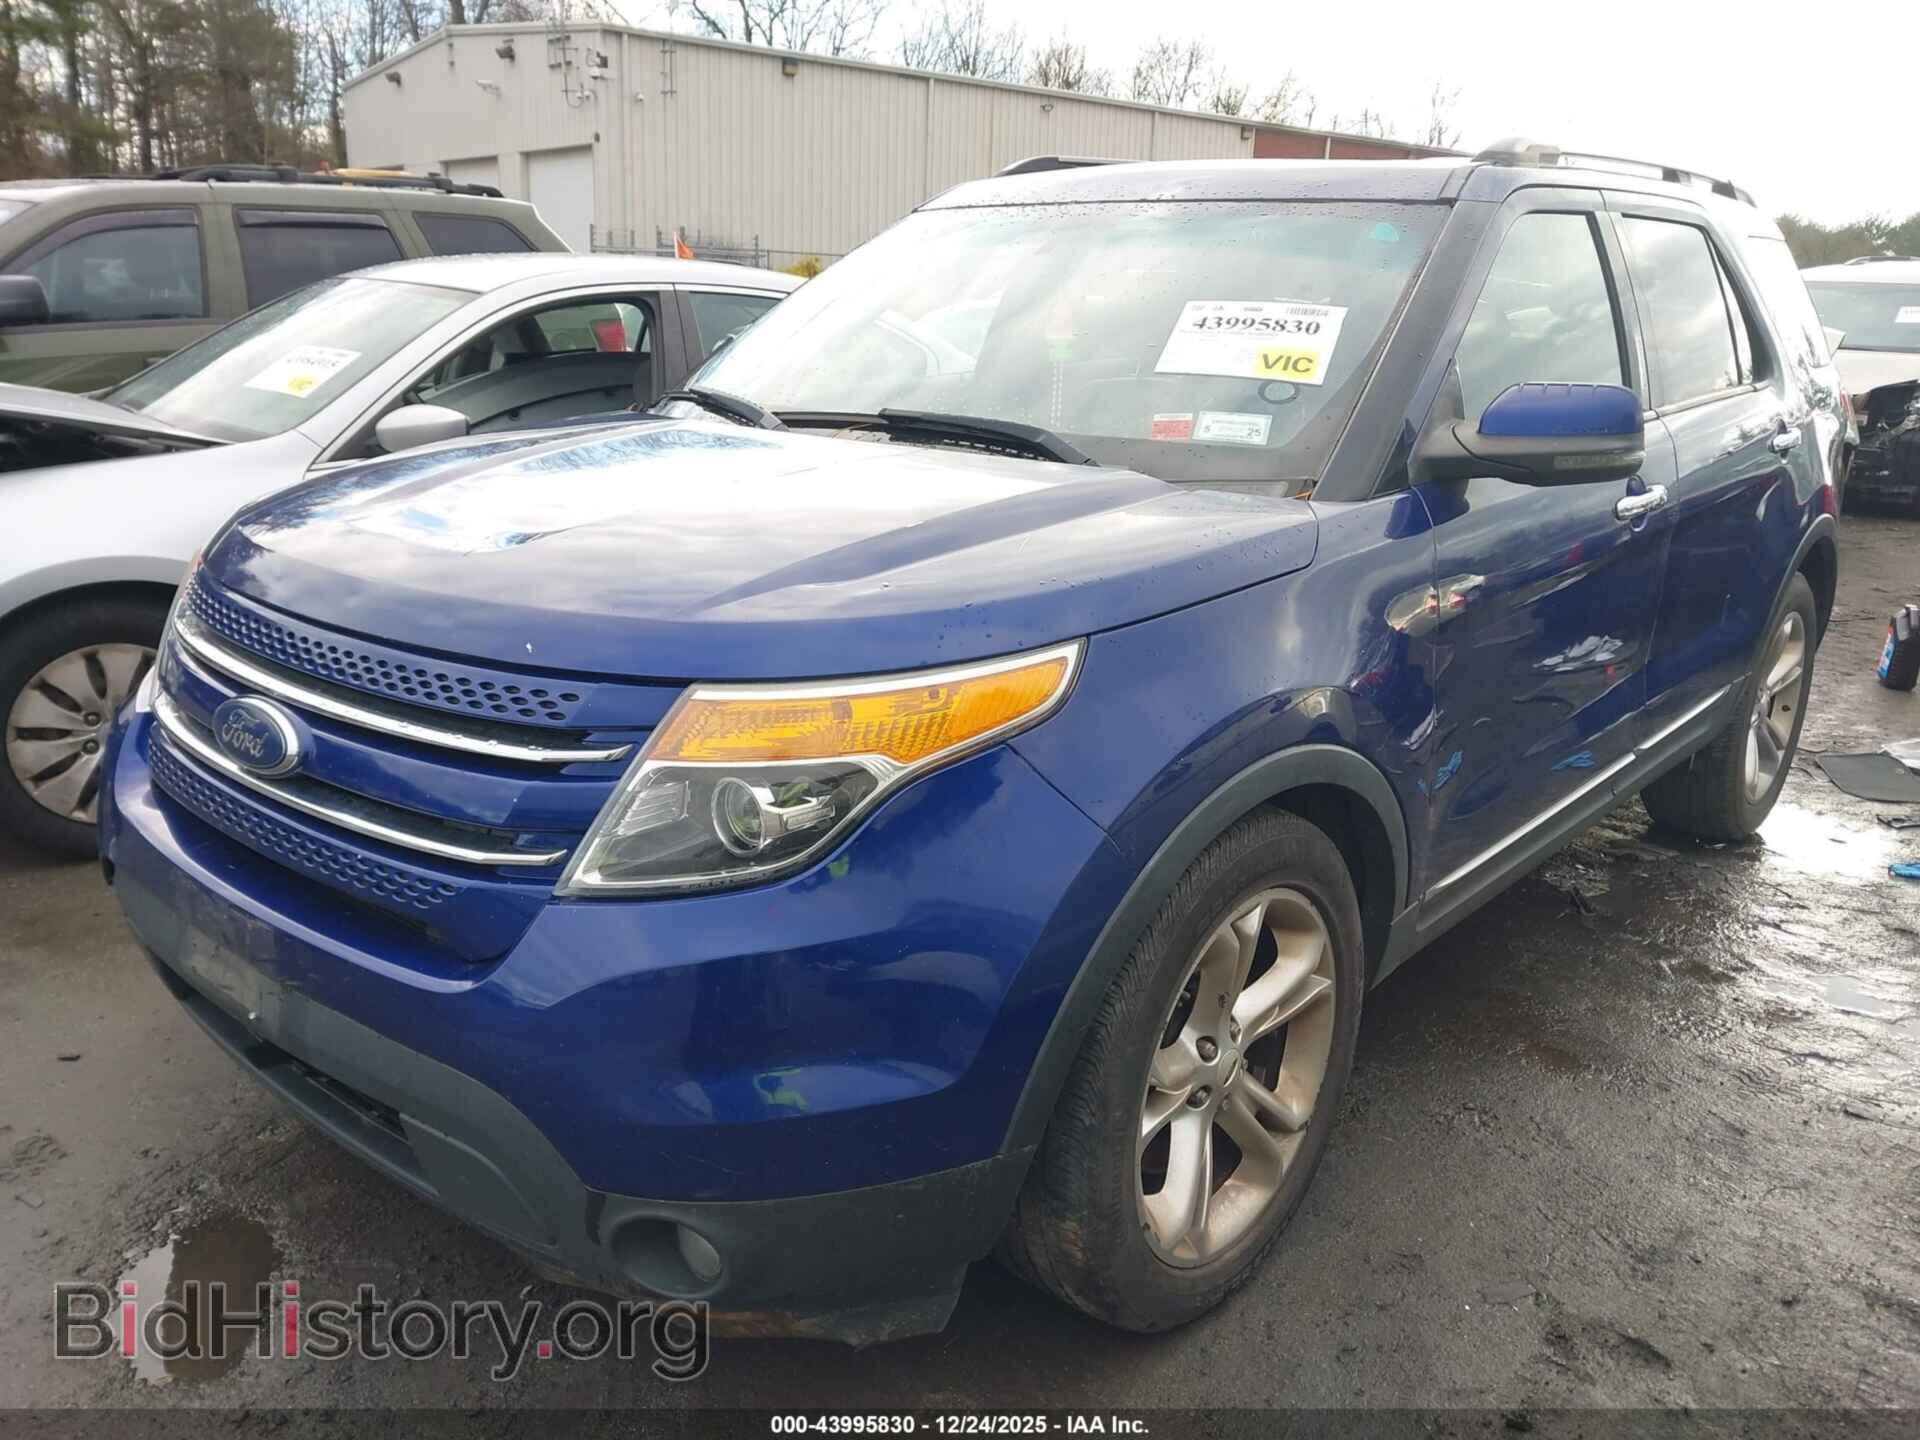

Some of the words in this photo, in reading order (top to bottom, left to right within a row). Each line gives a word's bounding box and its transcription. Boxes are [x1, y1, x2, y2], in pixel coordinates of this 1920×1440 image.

[1192, 315, 1321, 336] 43995830
[1261, 353, 1314, 373] VIC
[221, 709, 269, 758] Ford
